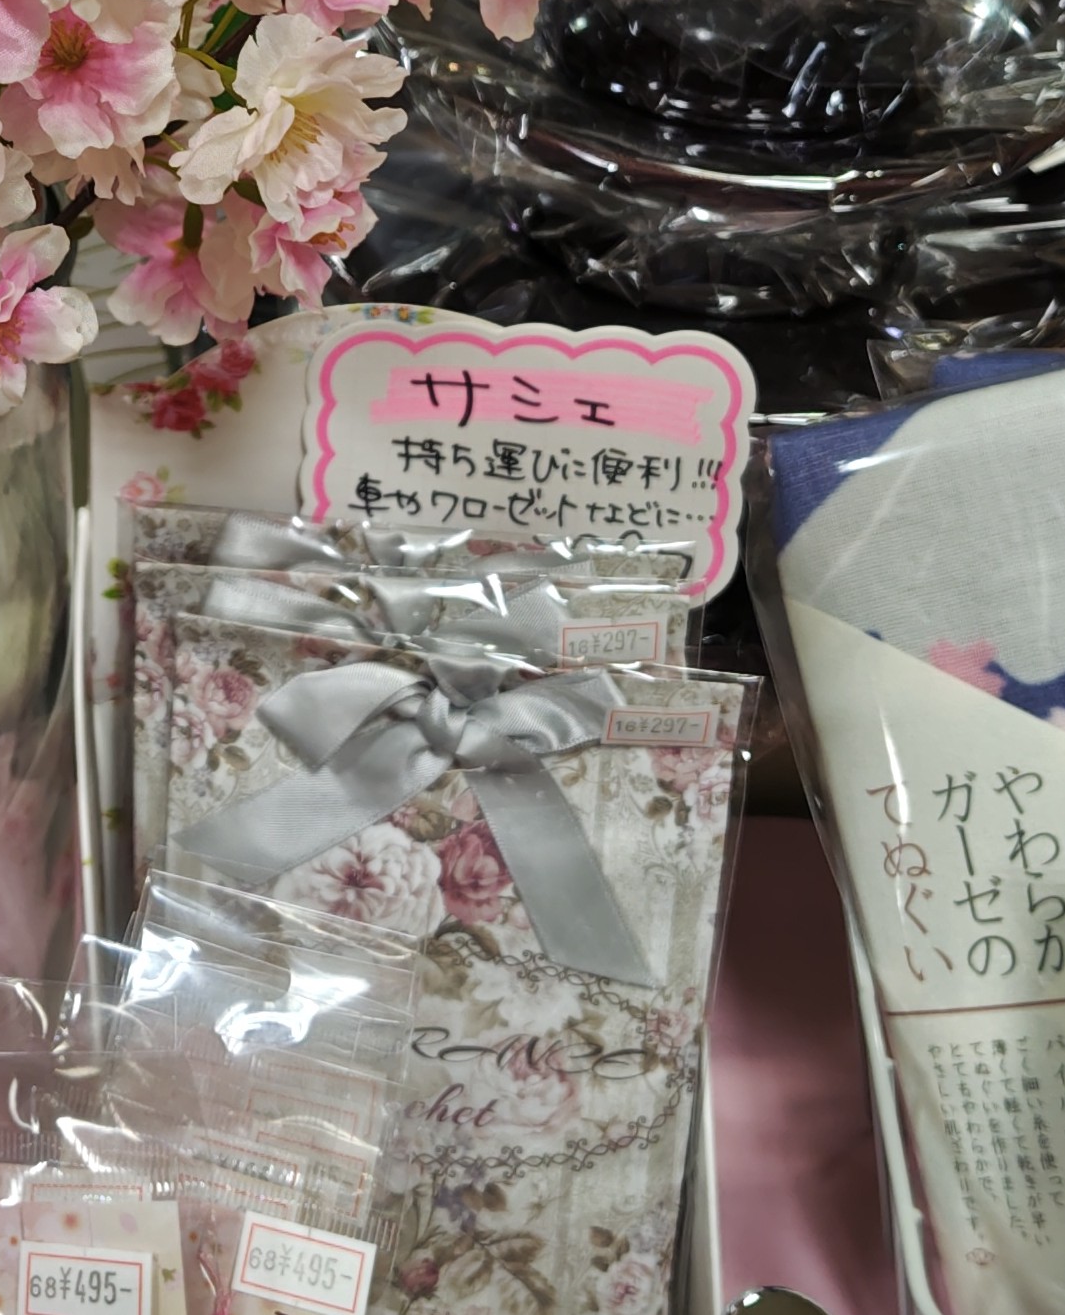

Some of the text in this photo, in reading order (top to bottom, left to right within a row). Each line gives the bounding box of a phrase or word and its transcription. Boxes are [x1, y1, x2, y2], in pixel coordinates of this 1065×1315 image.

[866, 781, 953, 982] てぬぐい
[932, 771, 1016, 976] ガーゼの
[30, 1266, 132, 1304] 68¥495-
[248, 1242, 353, 1290] 68¥495-
